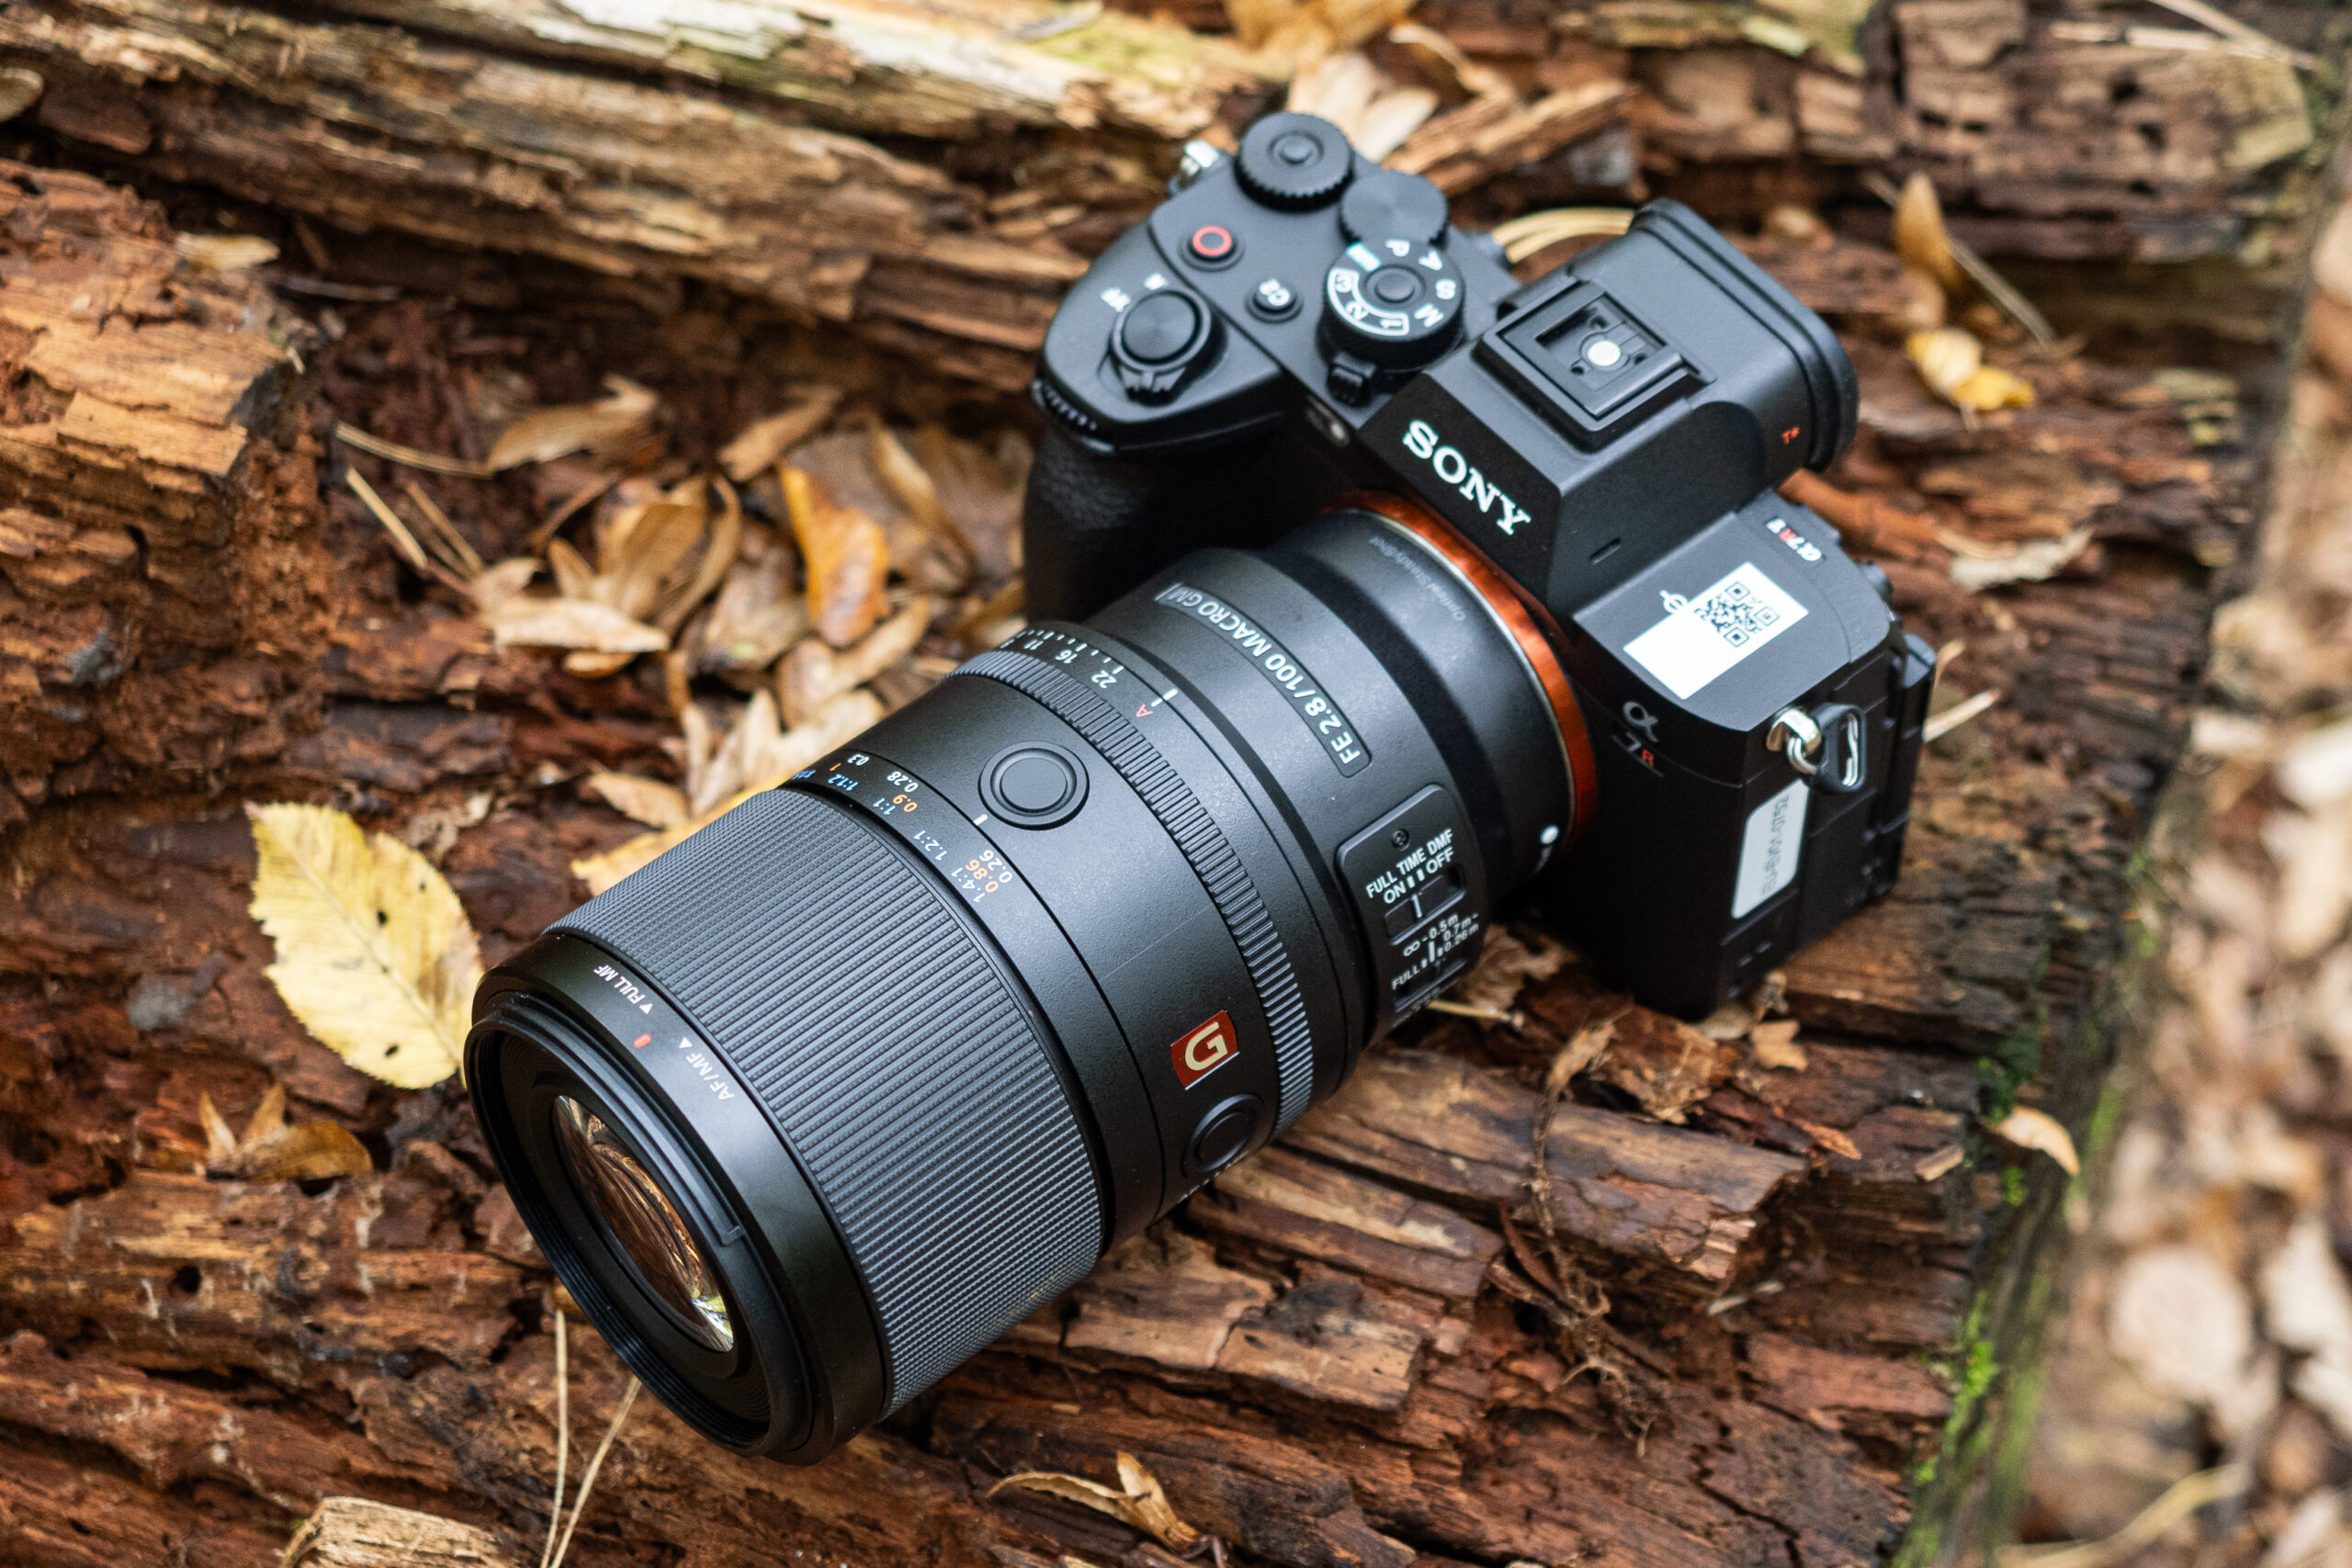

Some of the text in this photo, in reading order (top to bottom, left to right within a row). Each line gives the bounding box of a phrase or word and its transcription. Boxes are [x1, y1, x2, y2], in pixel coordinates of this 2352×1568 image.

[1385, 239, 1410, 257] P
[1414, 303, 1444, 328] M
[1402, 419, 1532, 536] SONY
[1168, 588, 1203, 607] GM
[1197, 601, 1272, 657] MACRO
[1055, 649, 1078, 664] 16
[1091, 670, 1116, 689] 22
[1136, 704, 1153, 717] A
[1329, 731, 1361, 764] FE
[847, 753, 1013, 883] 0.26 0.28 0.3
[872, 797, 896, 815] 1:1
[892, 794, 918, 813] 0.9
[913, 829, 947, 861] 1.2:1
[965, 859, 999, 893] 0.86
[1365, 829, 1453, 898] FULL TIME DMF
[1384, 846, 1453, 904] ON OFF
[951, 867, 986, 903] 1.4:1
[594, 964, 646, 1004] FULL MF
[1391, 965, 1420, 990] FULL
[1184, 1021, 1228, 1071] G
